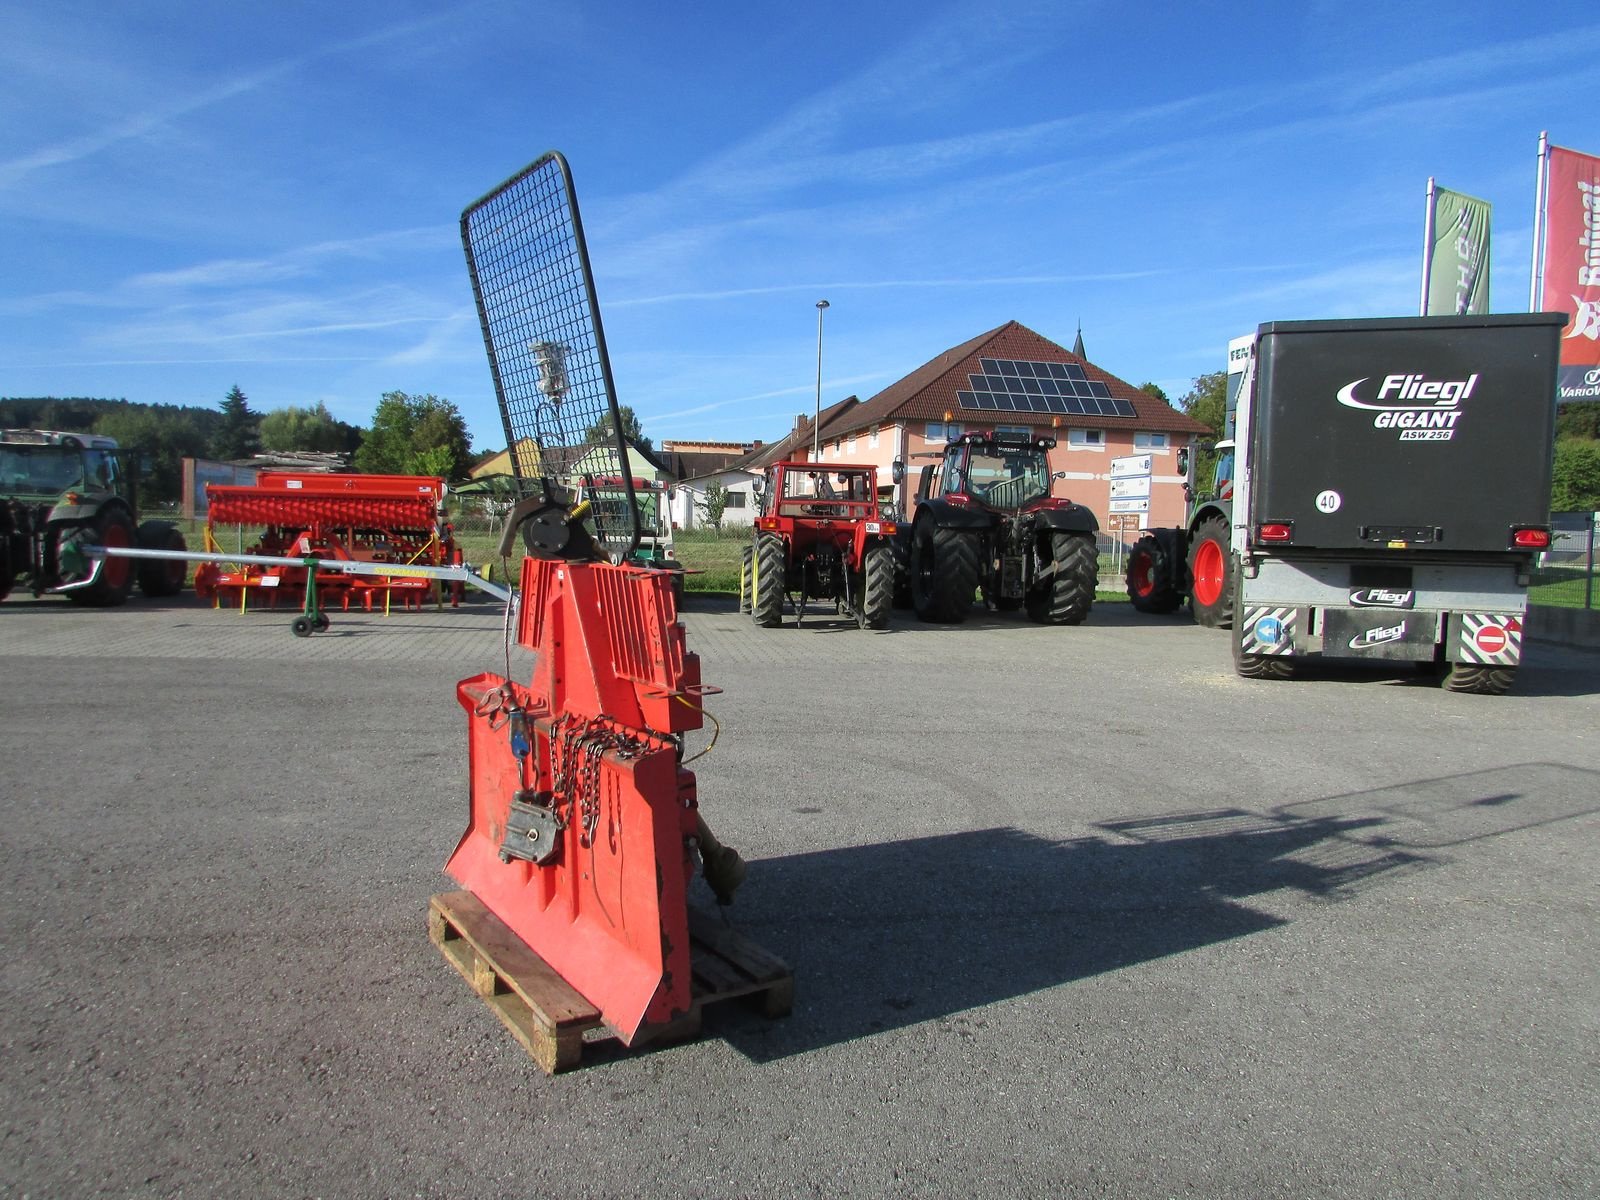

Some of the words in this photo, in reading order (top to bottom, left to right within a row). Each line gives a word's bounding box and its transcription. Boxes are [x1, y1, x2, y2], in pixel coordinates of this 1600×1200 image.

[1230, 346, 1249, 361] FEN
[1376, 373, 1478, 406] Fliegl
[1374, 411, 1462, 429] GIGANT
[1402, 431, 1427, 439] ASW
[1429, 431, 1450, 439] 256
[1320, 495, 1335, 509] 40
[1367, 589, 1412, 604] Fliegl
[1366, 620, 1405, 643] Fliegl
